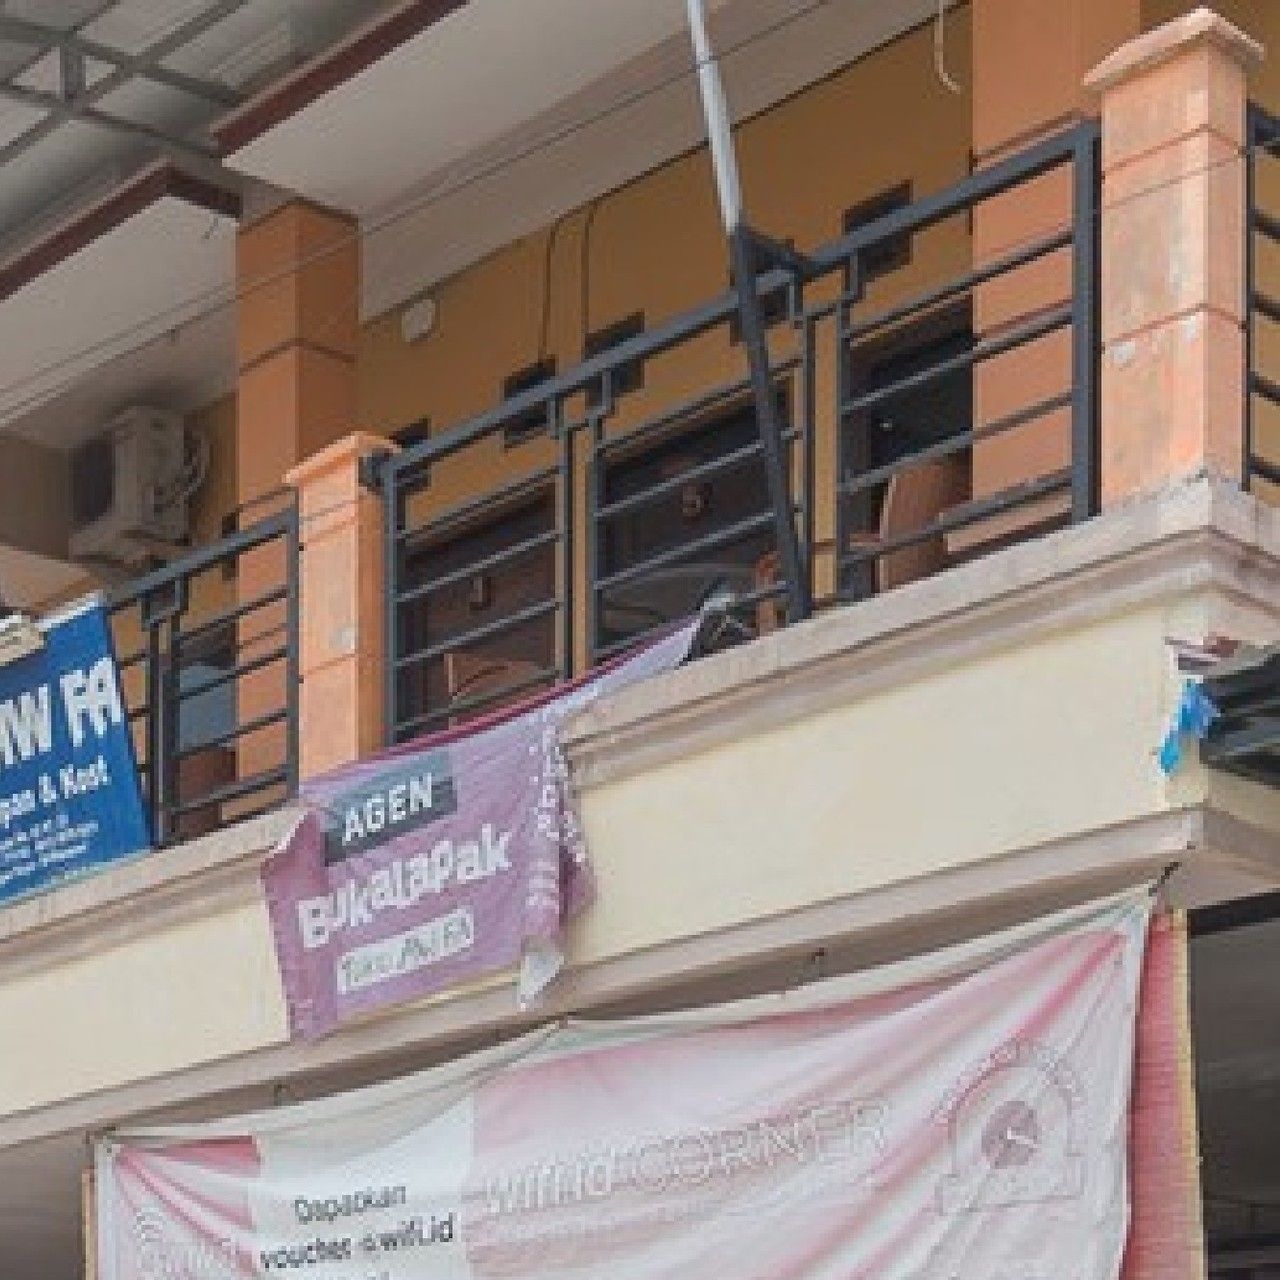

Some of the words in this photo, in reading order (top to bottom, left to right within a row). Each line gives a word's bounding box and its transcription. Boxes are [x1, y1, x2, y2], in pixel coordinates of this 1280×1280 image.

[59, 656, 124, 747] FA
[38, 773, 58, 806] &
[343, 773, 433, 843] AGEN
[297, 824, 513, 950] Bukalapak
[633, 1098, 893, 1194] CORNER
[259, 1235, 352, 1271] voucher
